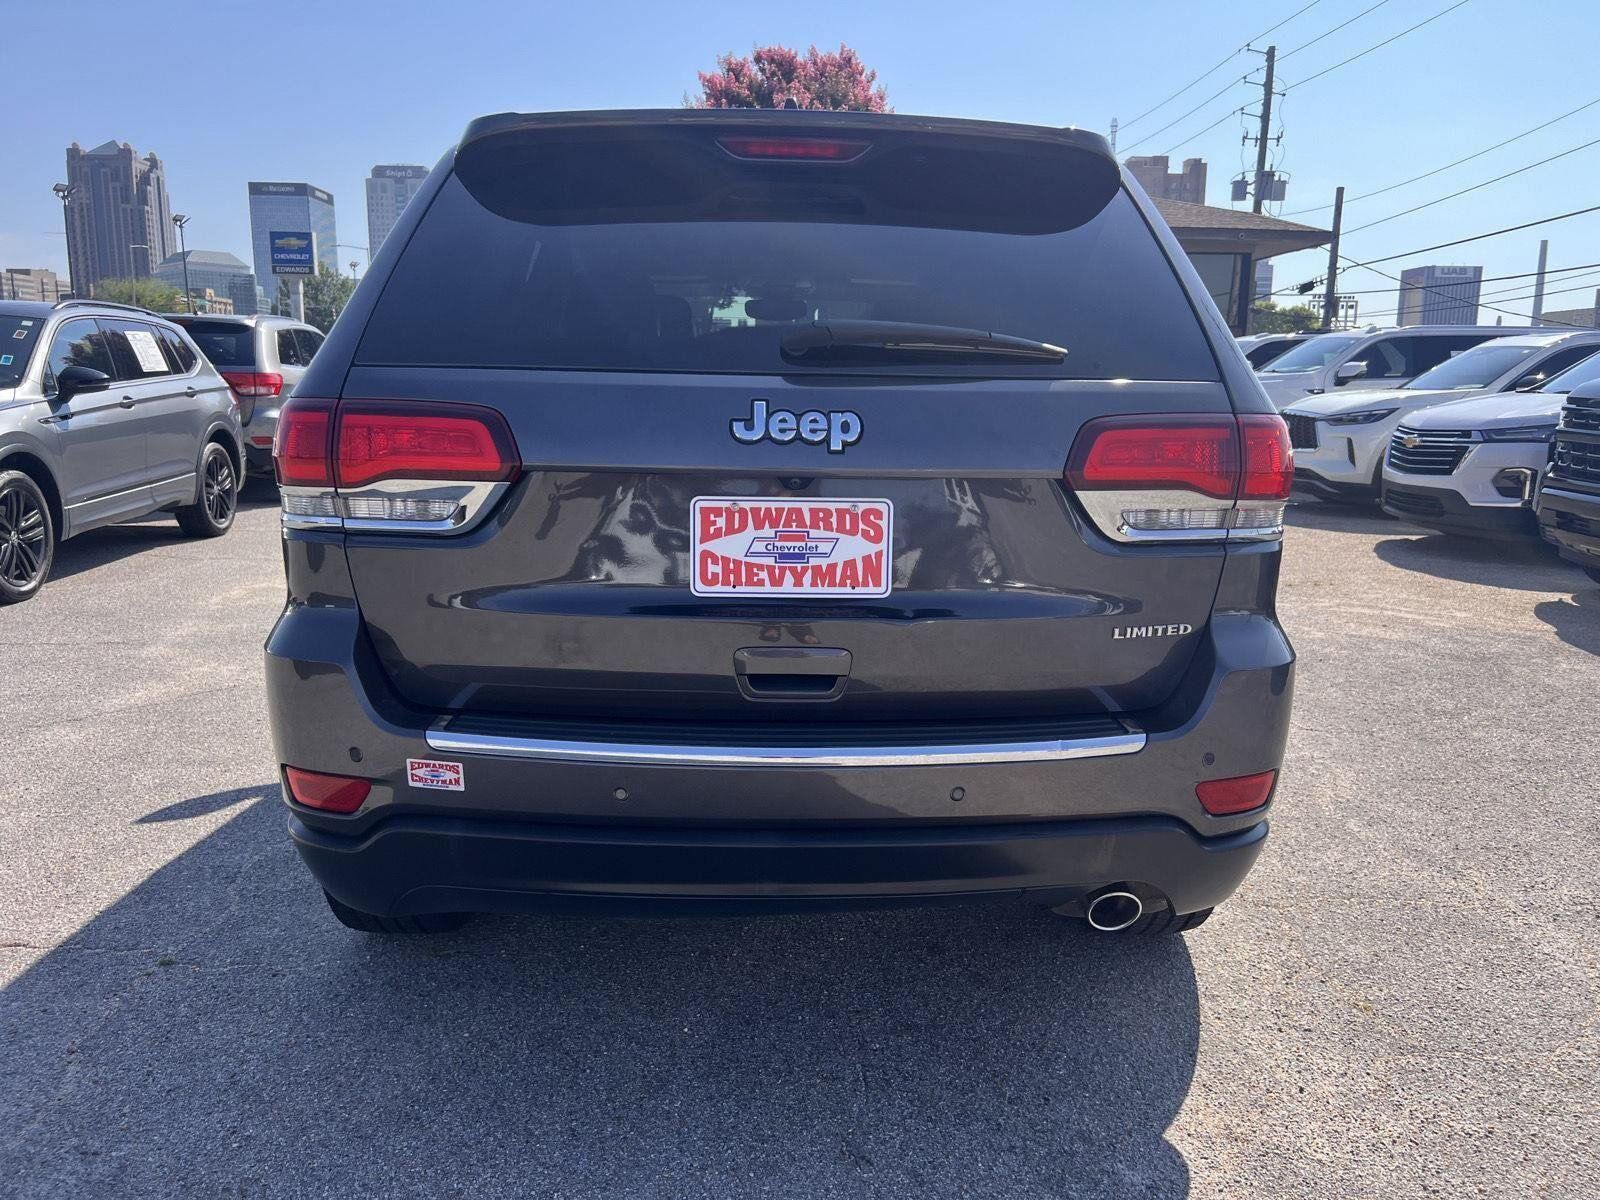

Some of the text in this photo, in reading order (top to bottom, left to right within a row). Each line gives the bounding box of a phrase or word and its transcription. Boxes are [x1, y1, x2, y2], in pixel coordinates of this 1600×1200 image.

[1440, 267, 1467, 276] UAB
[731, 400, 864, 453] Jeep
[699, 506, 884, 545] EDWARDS
[764, 541, 819, 553] Chevrolet
[699, 549, 884, 588] CHEVYMAN
[1112, 623, 1193, 639] LIMITED
[410, 761, 460, 775] EDWARDS
[410, 773, 461, 786] CHEVYMAN
